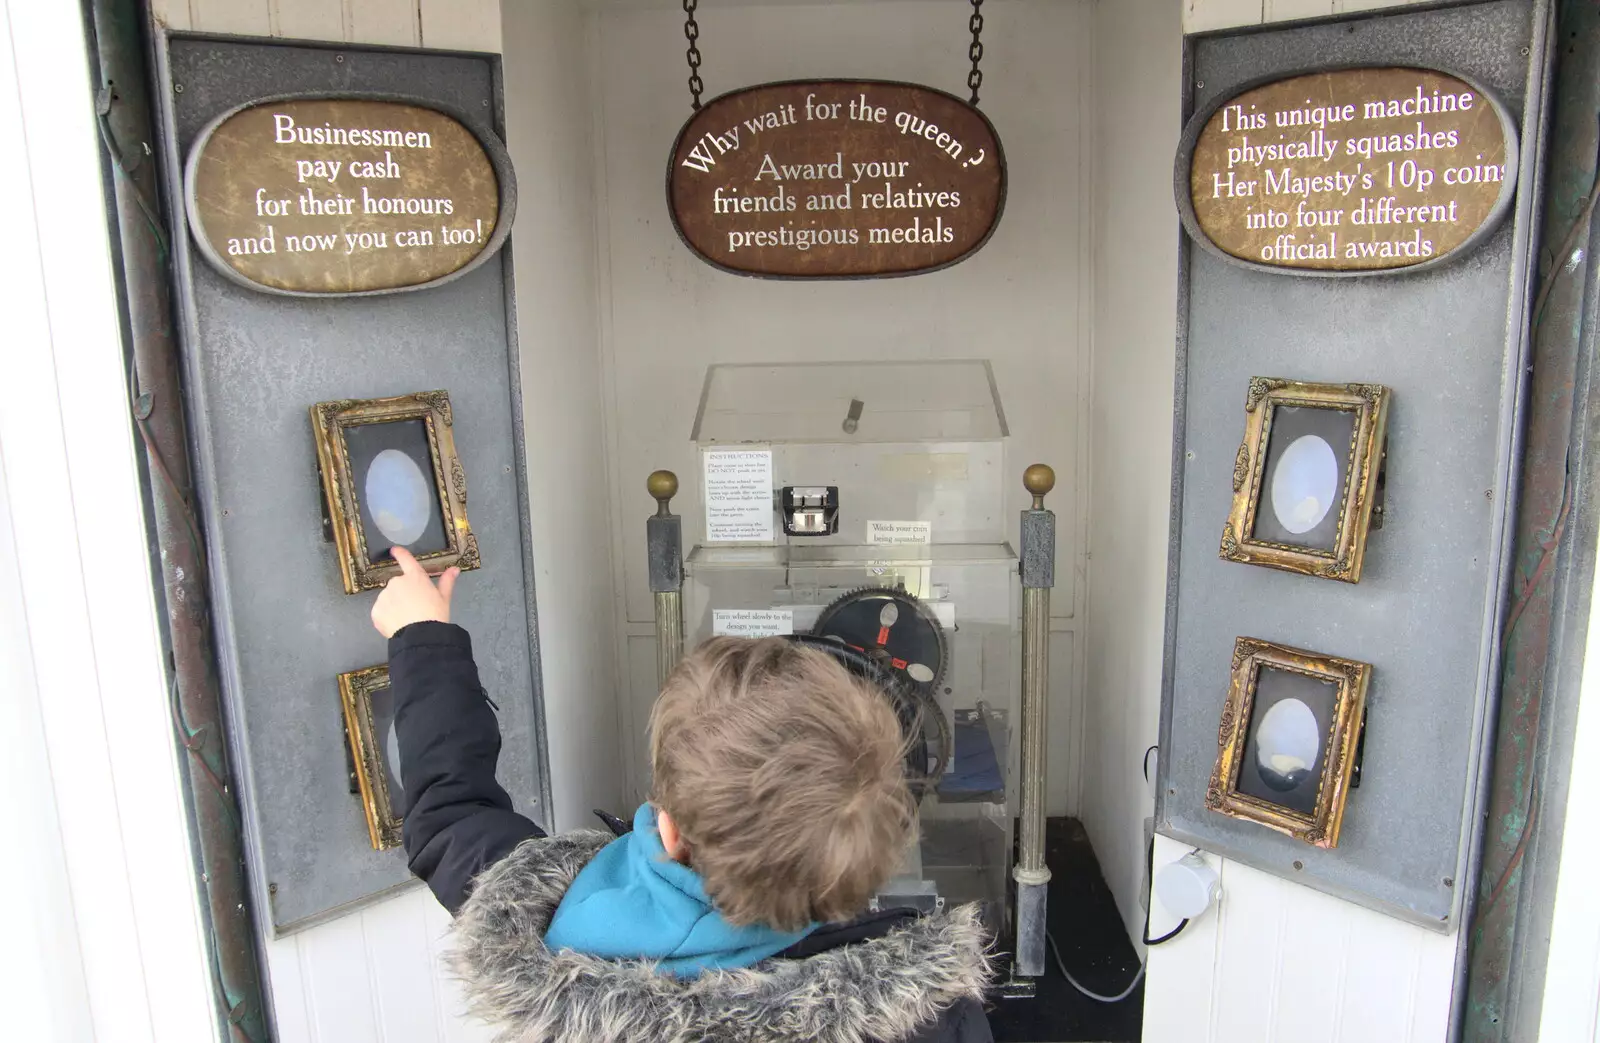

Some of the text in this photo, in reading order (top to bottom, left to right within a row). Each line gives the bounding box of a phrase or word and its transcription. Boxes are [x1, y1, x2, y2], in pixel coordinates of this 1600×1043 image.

[1221, 86, 1473, 132] This unique machine
[273, 114, 432, 149] Businessmen
[682, 126, 739, 173] Why
[744, 104, 796, 136] wait
[805, 94, 842, 121] for
[849, 95, 887, 123] the
[1227, 121, 1459, 168] physically squashes
[296, 152, 400, 183] pay cash
[754, 152, 909, 184] Award your
[1212, 172, 1257, 199] Her
[1265, 163, 1373, 198] Majesty's
[1387, 160, 1434, 192] 10p
[255, 187, 454, 217] for their honours
[713, 182, 961, 214] friends and relatives
[1246, 197, 1457, 230] into four different
[228, 219, 483, 256] and now you can too!
[728, 217, 954, 252] prestigious medals
[1260, 230, 1433, 261] official awards
[872, 523, 894, 531] Watch
[873, 533, 893, 543] being
[726, 622, 747, 631] design
[732, 612, 751, 620] wheel
[752, 612, 772, 621] slowly
